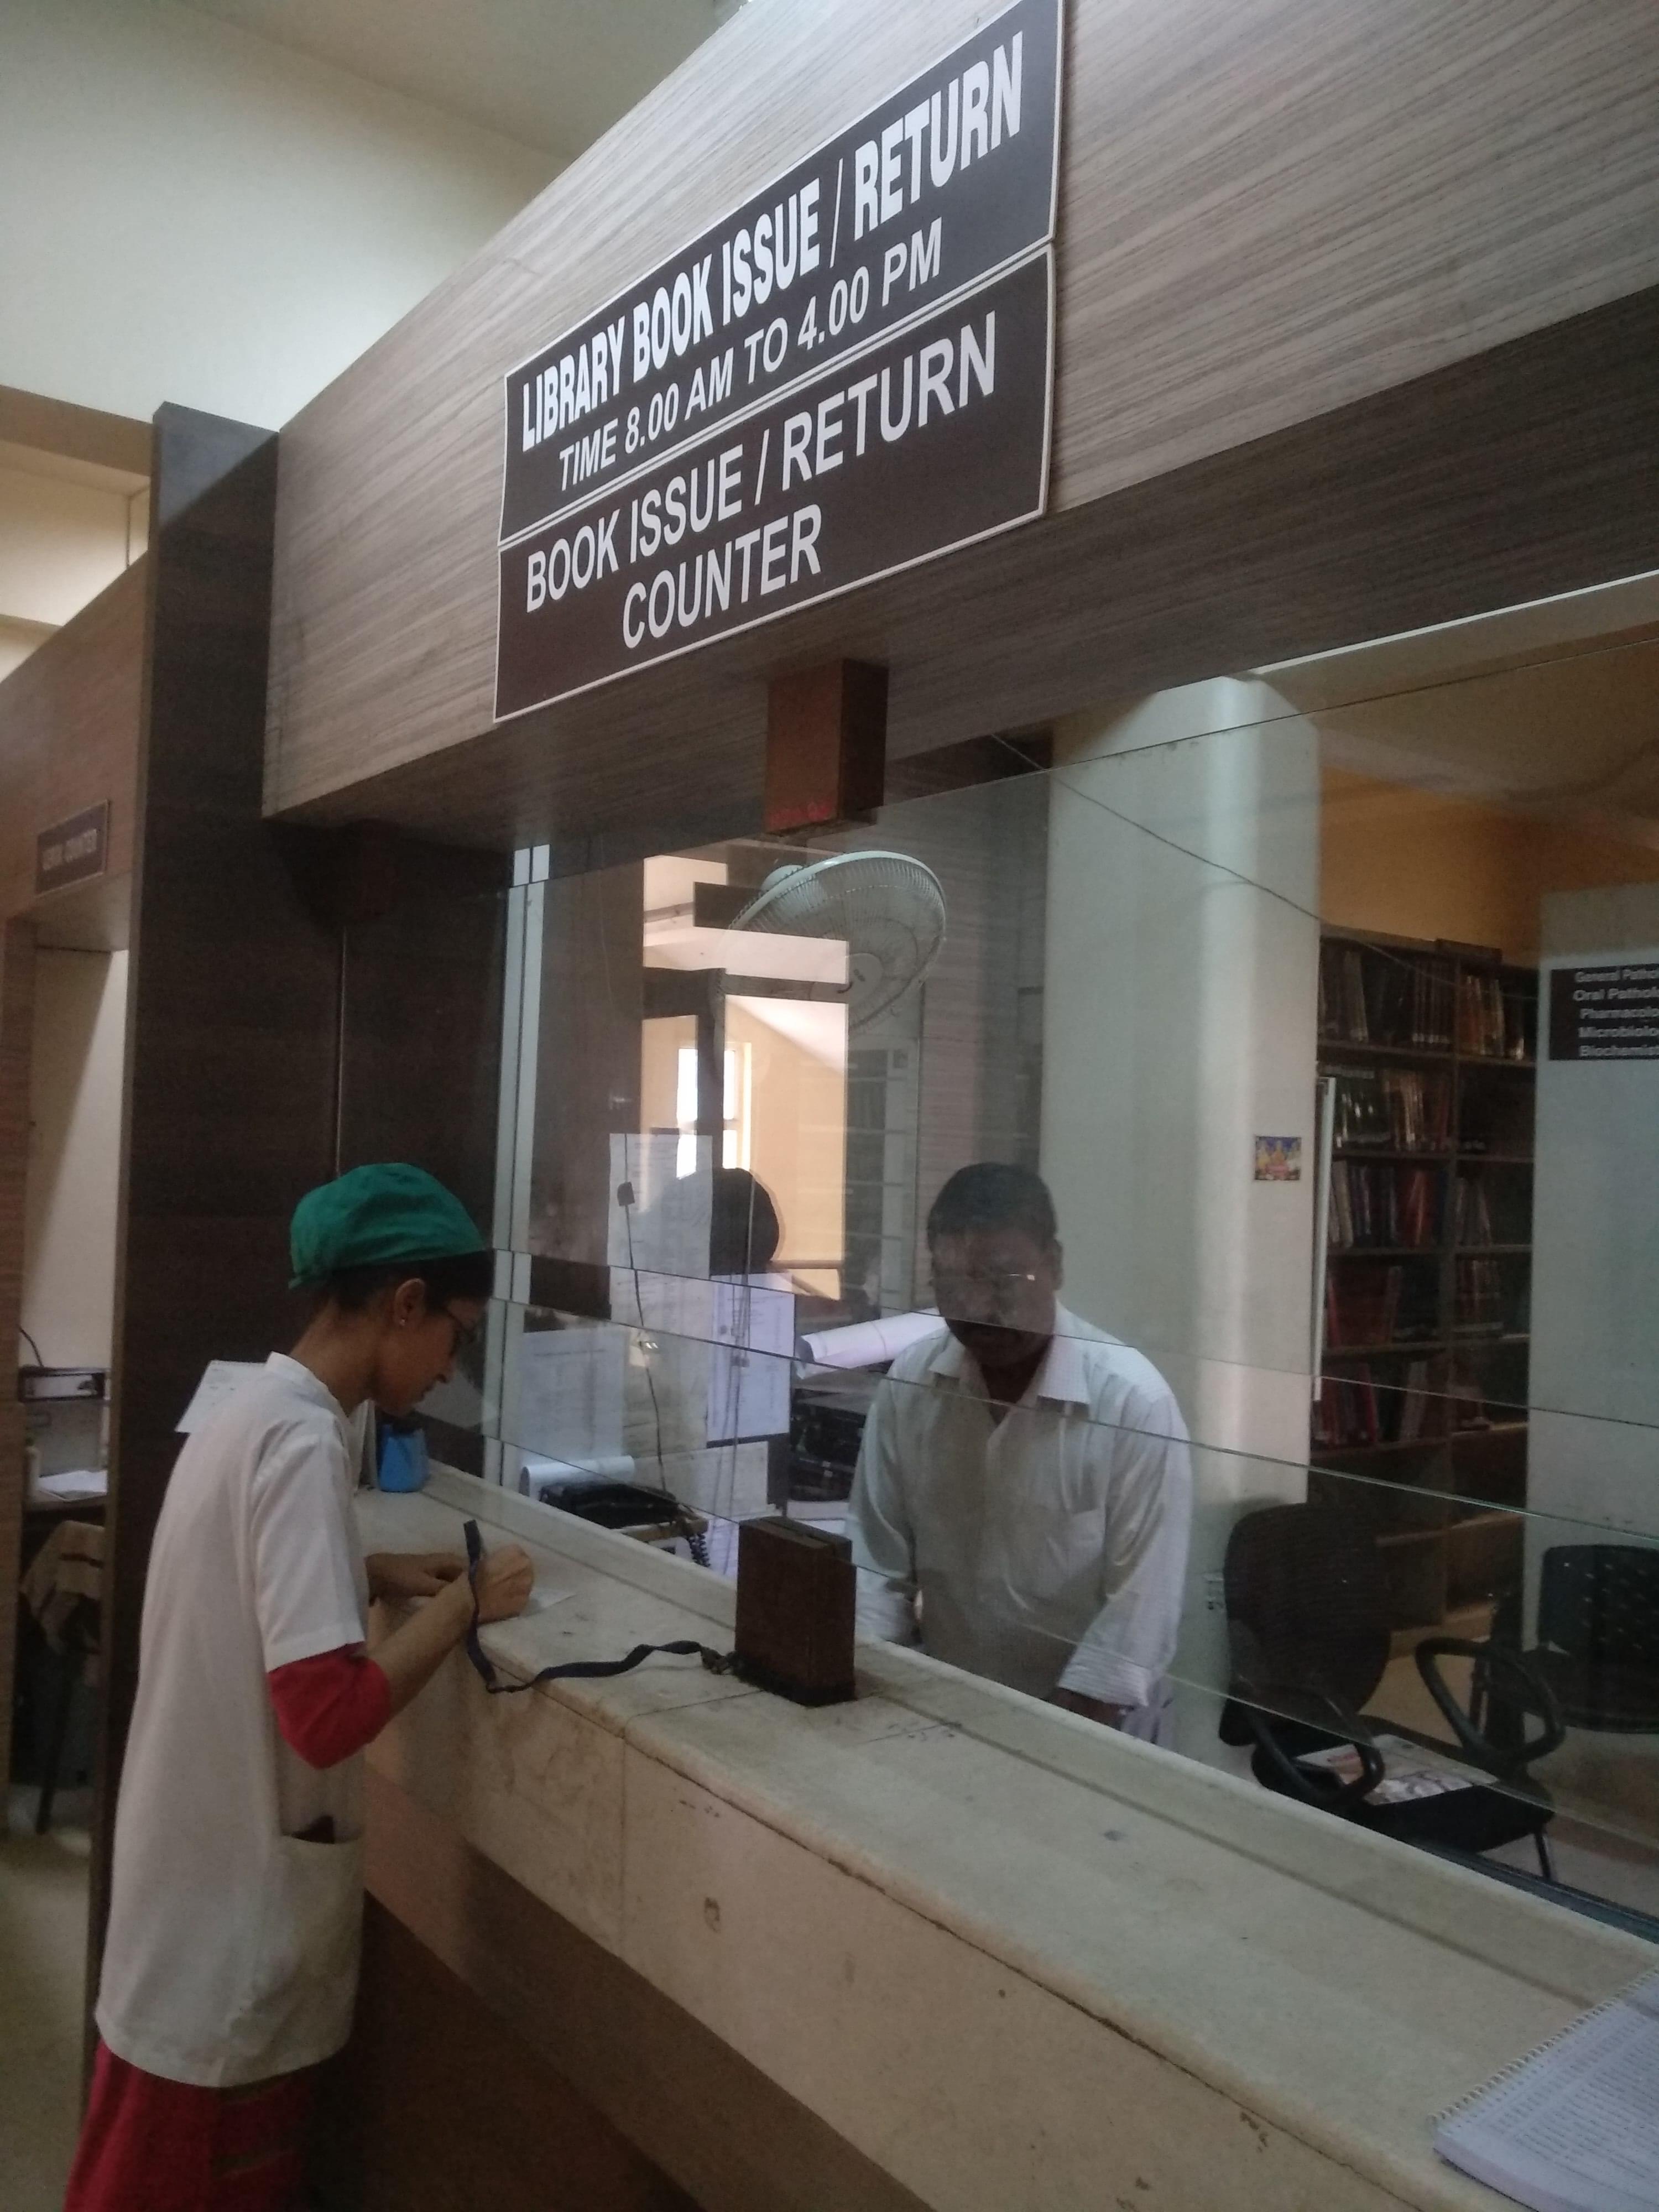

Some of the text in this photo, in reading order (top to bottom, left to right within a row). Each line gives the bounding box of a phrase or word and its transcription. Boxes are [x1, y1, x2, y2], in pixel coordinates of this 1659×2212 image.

[522, 33, 1024, 452] LIBRARY BOOK ISSUE / RETURN
[559, 217, 942, 492] TIME 8.00 AM TO 4.00 PM
[526, 311, 995, 613] BOOK ISSUE / RETURN
[623, 504, 822, 649] COUNTER
